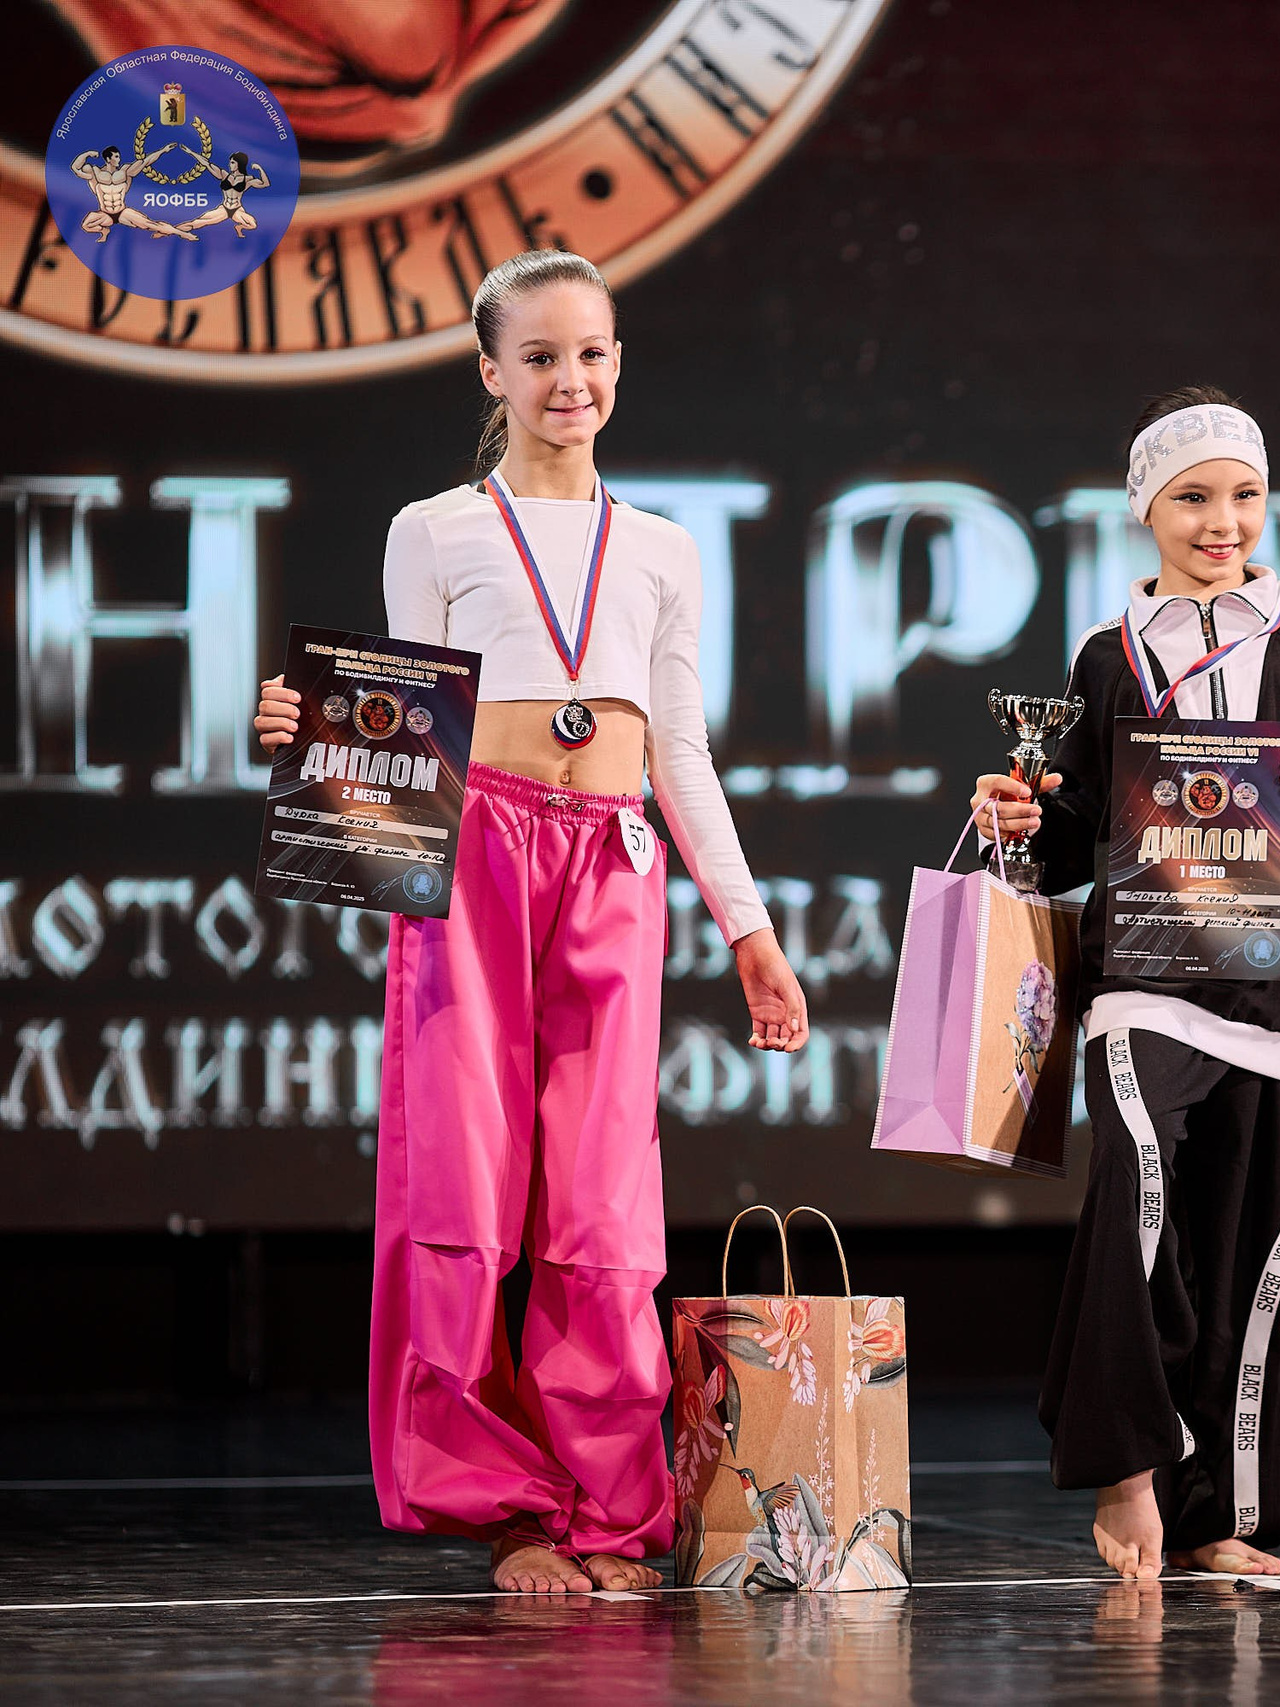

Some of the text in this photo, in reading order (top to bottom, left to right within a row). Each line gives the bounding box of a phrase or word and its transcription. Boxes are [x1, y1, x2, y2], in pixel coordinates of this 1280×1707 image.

[305, 643, 470, 676] ГРАН-ПРИ СТОЛИЦЫ ЗОЛОТОГО
[335, 659, 381, 674] КОЛЬЦА
[382, 665, 425, 681] РОССИИ
[334, 669, 345, 677] ПО
[345, 670, 398, 684] БОДИБИЛДИНГУ
[404, 678, 436, 690] ФИТНЕСУ
[1182, 736, 1233, 746] СТОЛИЦЫ
[1205, 746, 1247, 757] РОССИИ
[300, 741, 440, 793] ДИПЛОМ
[341, 786, 392, 805] 2 МЕСТО
[629, 824, 647, 853] 57
[1137, 825, 1269, 865] ДИПЛОМ
[1179, 865, 1226, 879] 1 МЕСТО
[1110, 1039, 1137, 1101] BLACK BEARS
[1141, 1144, 1161, 1230] BLACK BEARS
[1238, 1363, 1261, 1451] BLACK BEARS
